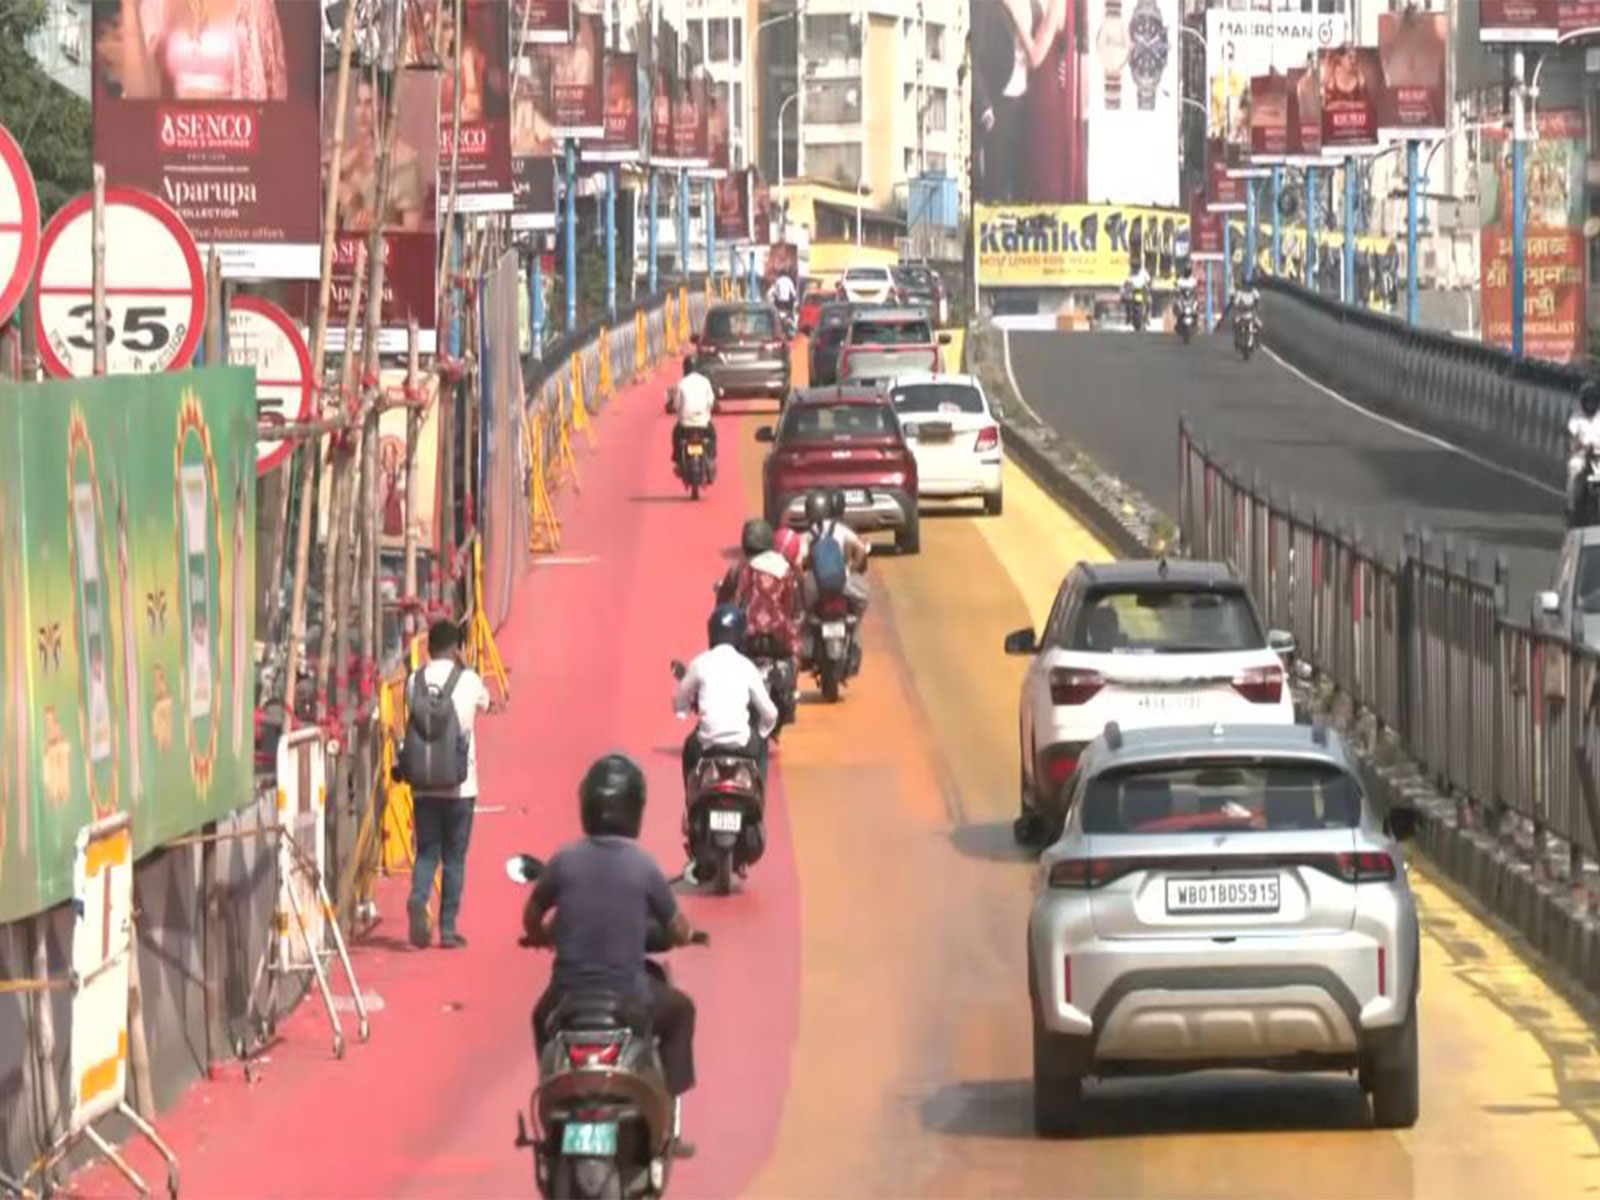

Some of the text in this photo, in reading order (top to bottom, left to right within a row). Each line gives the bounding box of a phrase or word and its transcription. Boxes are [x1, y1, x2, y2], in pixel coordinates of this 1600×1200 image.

[176, 114, 252, 138] SENCO
[163, 175, 257, 206] Aparupa
[67, 303, 170, 352] 35
